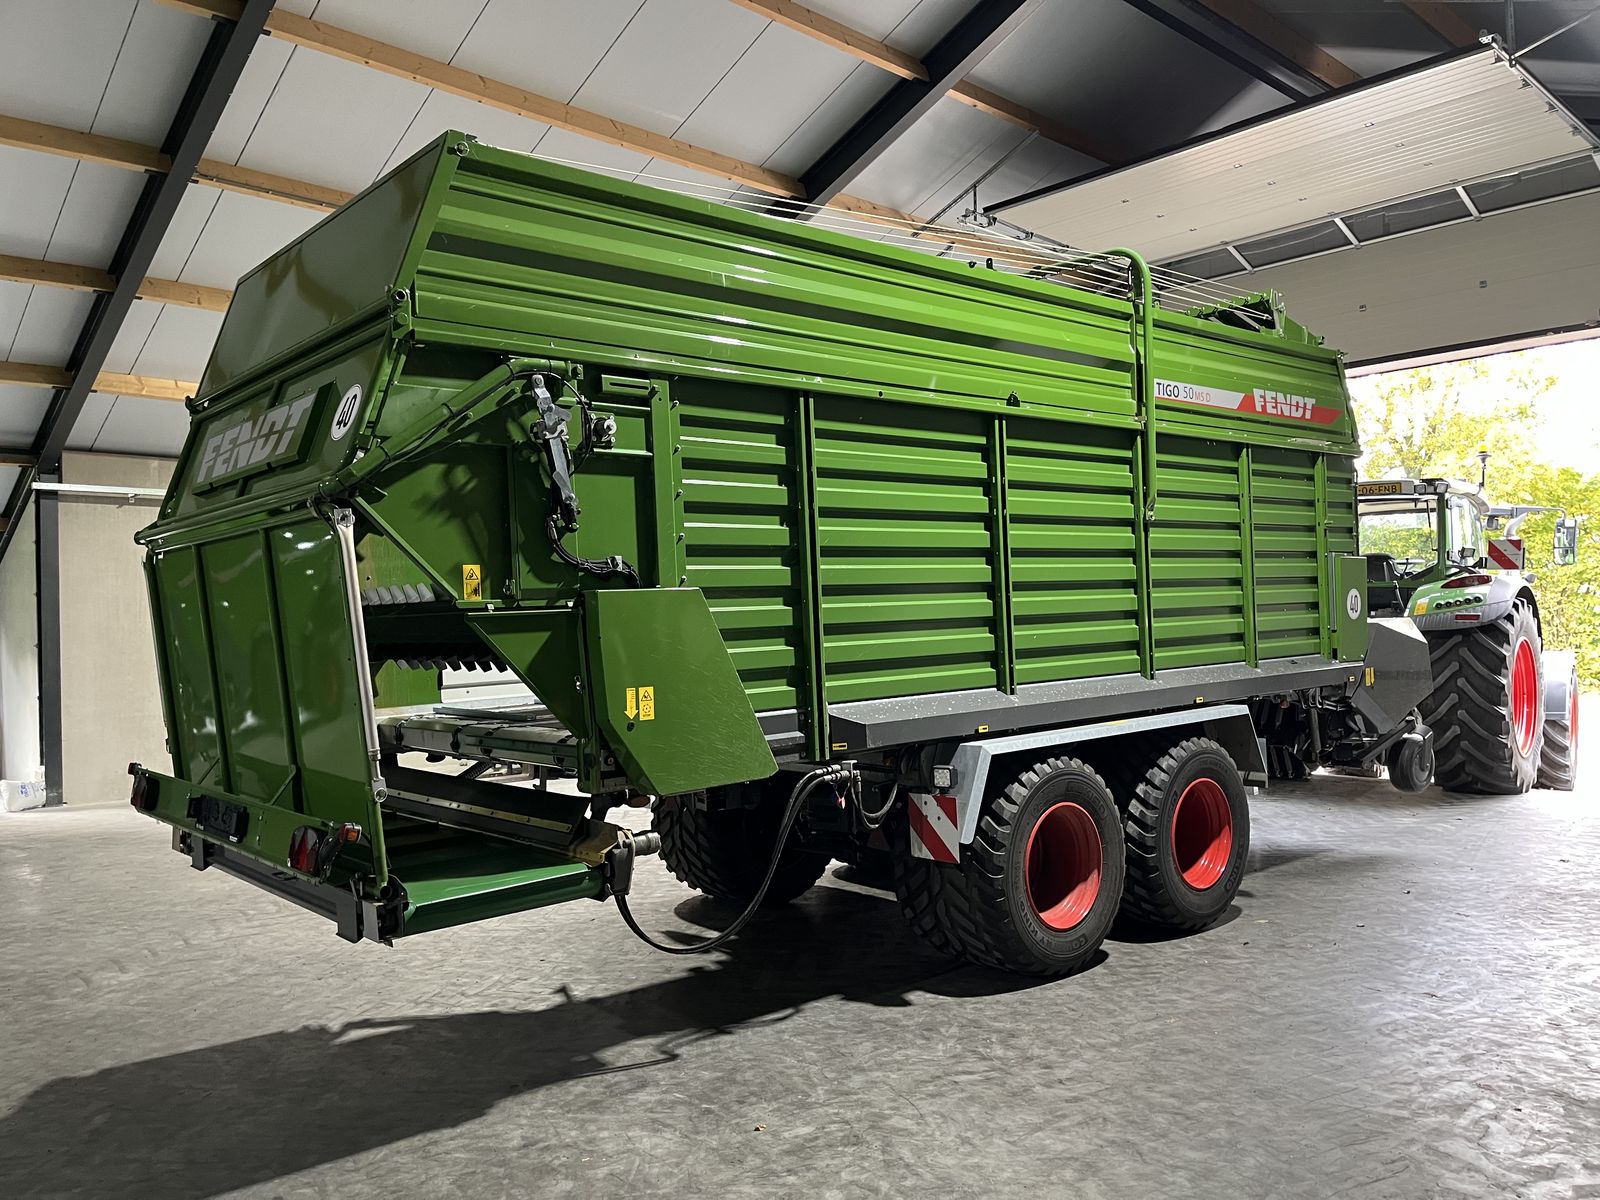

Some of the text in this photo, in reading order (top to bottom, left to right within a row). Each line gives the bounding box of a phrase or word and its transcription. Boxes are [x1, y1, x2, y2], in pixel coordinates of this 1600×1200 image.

[1156, 382, 1180, 398] TIGO
[1183, 386, 1194, 400] 50
[1253, 388, 1315, 419] FENDT
[336, 393, 358, 430] 40
[197, 393, 316, 483] FENDT
[1350, 594, 1359, 613] 40
